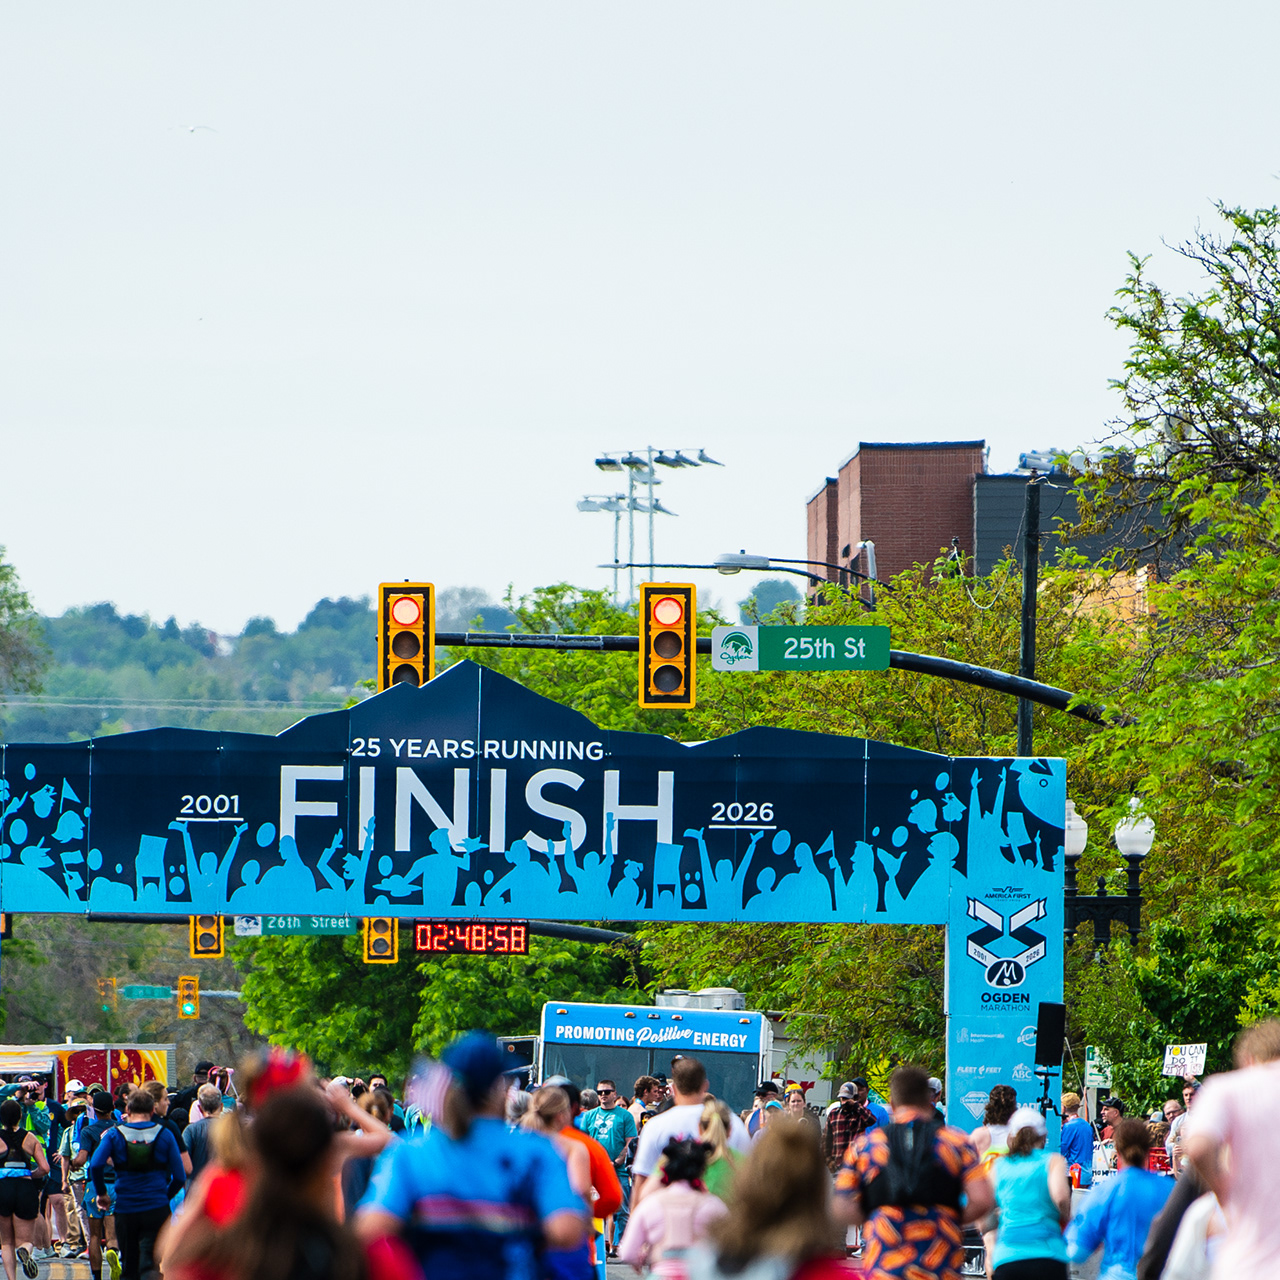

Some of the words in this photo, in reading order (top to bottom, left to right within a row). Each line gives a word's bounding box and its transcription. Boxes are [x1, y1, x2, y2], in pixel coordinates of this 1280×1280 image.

[784, 637, 835, 659] 25th
[844, 637, 866, 658] St
[720, 651, 753, 665] Ogden
[352, 738, 380, 758] 25
[390, 738, 475, 760] YEARS
[483, 739, 604, 762] RUNNING
[180, 794, 239, 815] 2001
[280, 765, 674, 855] FINISH
[711, 802, 774, 823] 2026
[267, 917, 300, 929] 26th
[310, 917, 350, 929] Street
[416, 924, 526, 952] 02:48:58
[973, 948, 988, 962] 2001
[981, 992, 1030, 1004] OGDEN
[980, 1004, 1031, 1012] MARATHON
[555, 1025, 635, 1042] PROMOTING
[635, 1025, 694, 1047] Positive
[693, 1032, 748, 1048] ENERGY
[1188, 1044, 1206, 1056] CAN
[1171, 1056, 1186, 1065] DO
[1012, 1070, 1032, 1079] ABC
